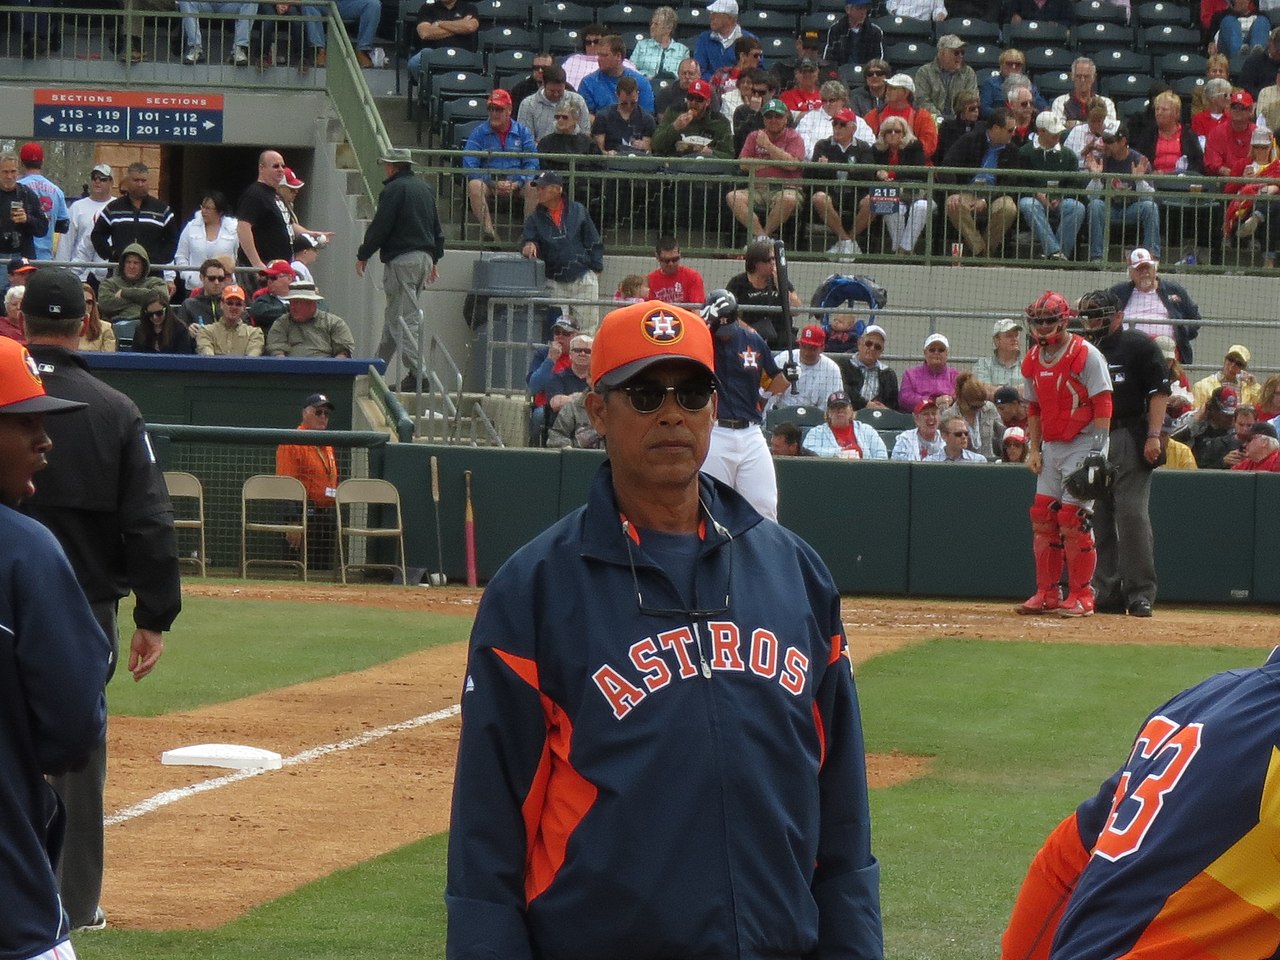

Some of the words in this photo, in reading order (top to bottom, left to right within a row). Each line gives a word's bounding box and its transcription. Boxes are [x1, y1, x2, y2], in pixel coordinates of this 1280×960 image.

[51, 94, 113, 103] SECTIONS
[146, 97, 207, 106] SECTIONS
[60, 109, 84, 119] 113
[97, 110, 120, 120] 119
[138, 112, 159, 121] 101
[174, 113, 198, 122] 112
[58, 123, 84, 133] 216
[95, 124, 120, 133] 220
[136, 125, 159, 135] 201
[172, 126, 198, 136] 215
[873, 188, 897, 197] 215
[651, 316, 675, 336] H
[742, 351, 758, 367] H
[592, 620, 809, 721] ASTROS
